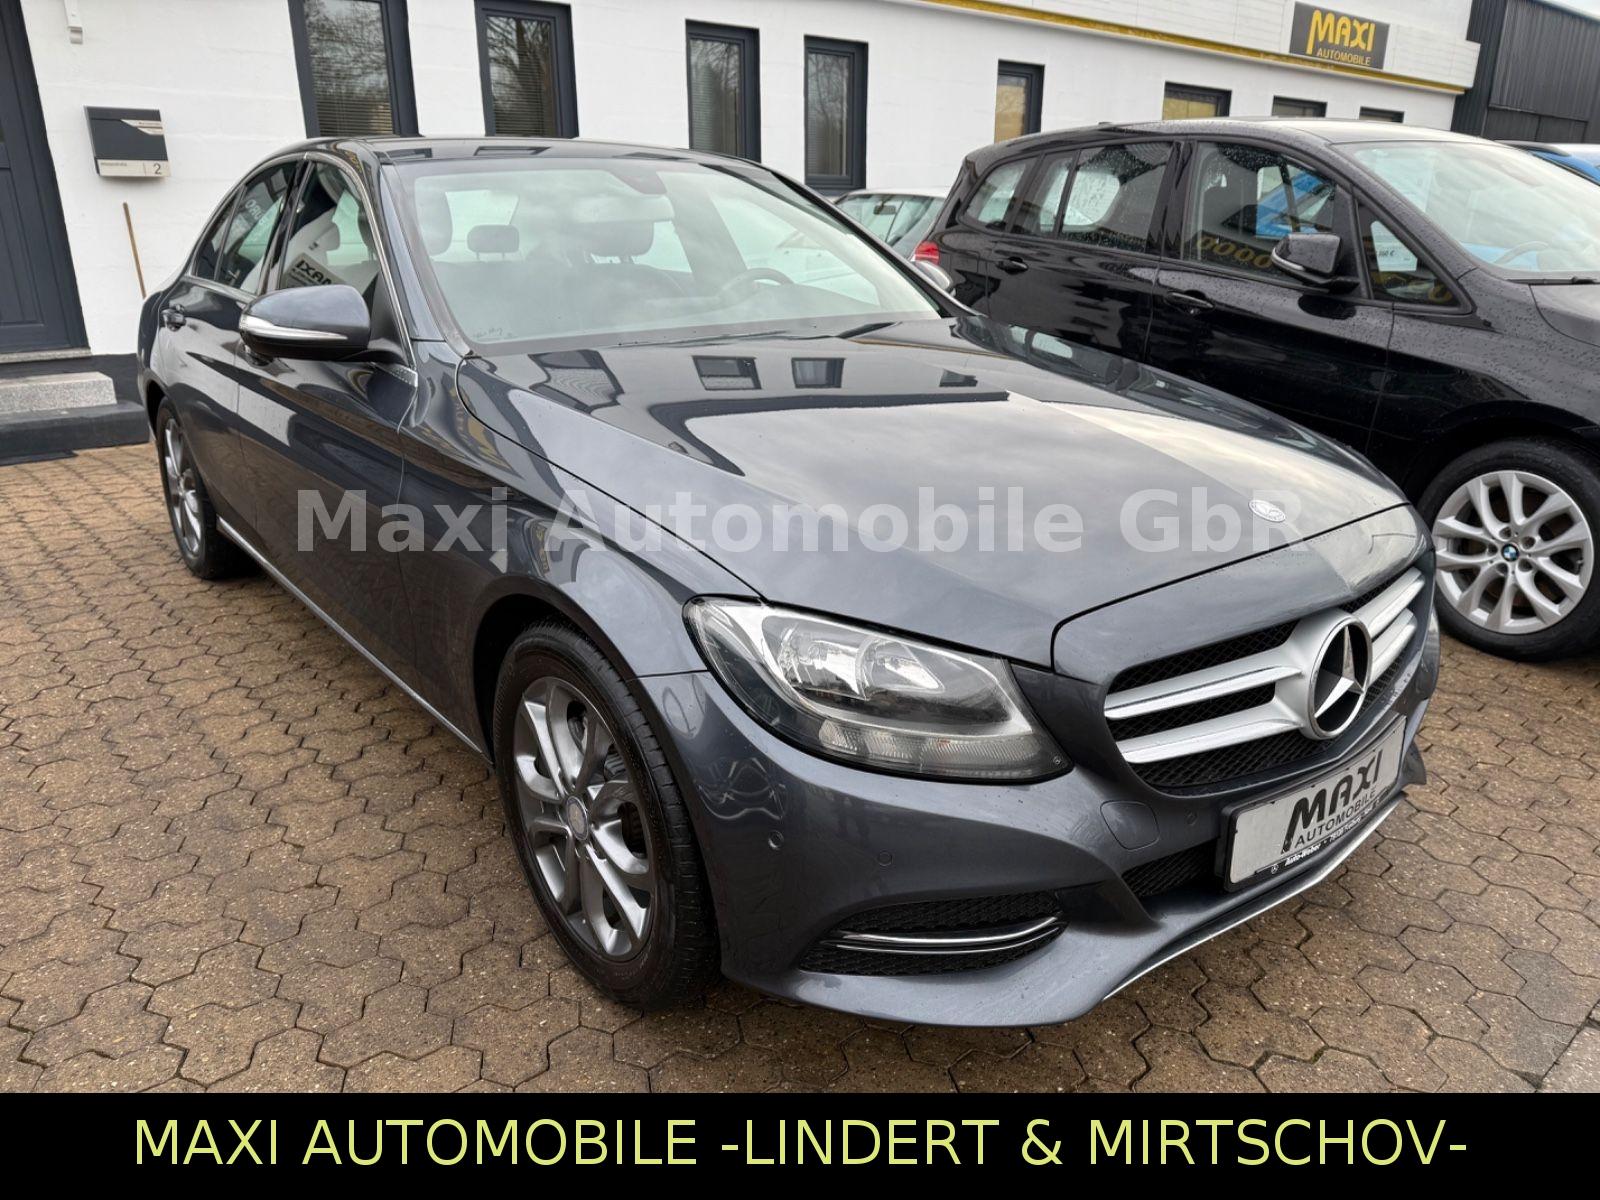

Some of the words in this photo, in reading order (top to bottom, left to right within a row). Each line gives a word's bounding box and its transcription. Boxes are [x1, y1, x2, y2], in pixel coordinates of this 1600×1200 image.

[1306, 9, 1376, 55] MAXI
[1316, 48, 1372, 66] AUTOMOBILE
[153, 162, 162, 175] 2
[1281, 749, 1383, 855] MAXI
[1295, 789, 1376, 849] AUTOMOBILE
